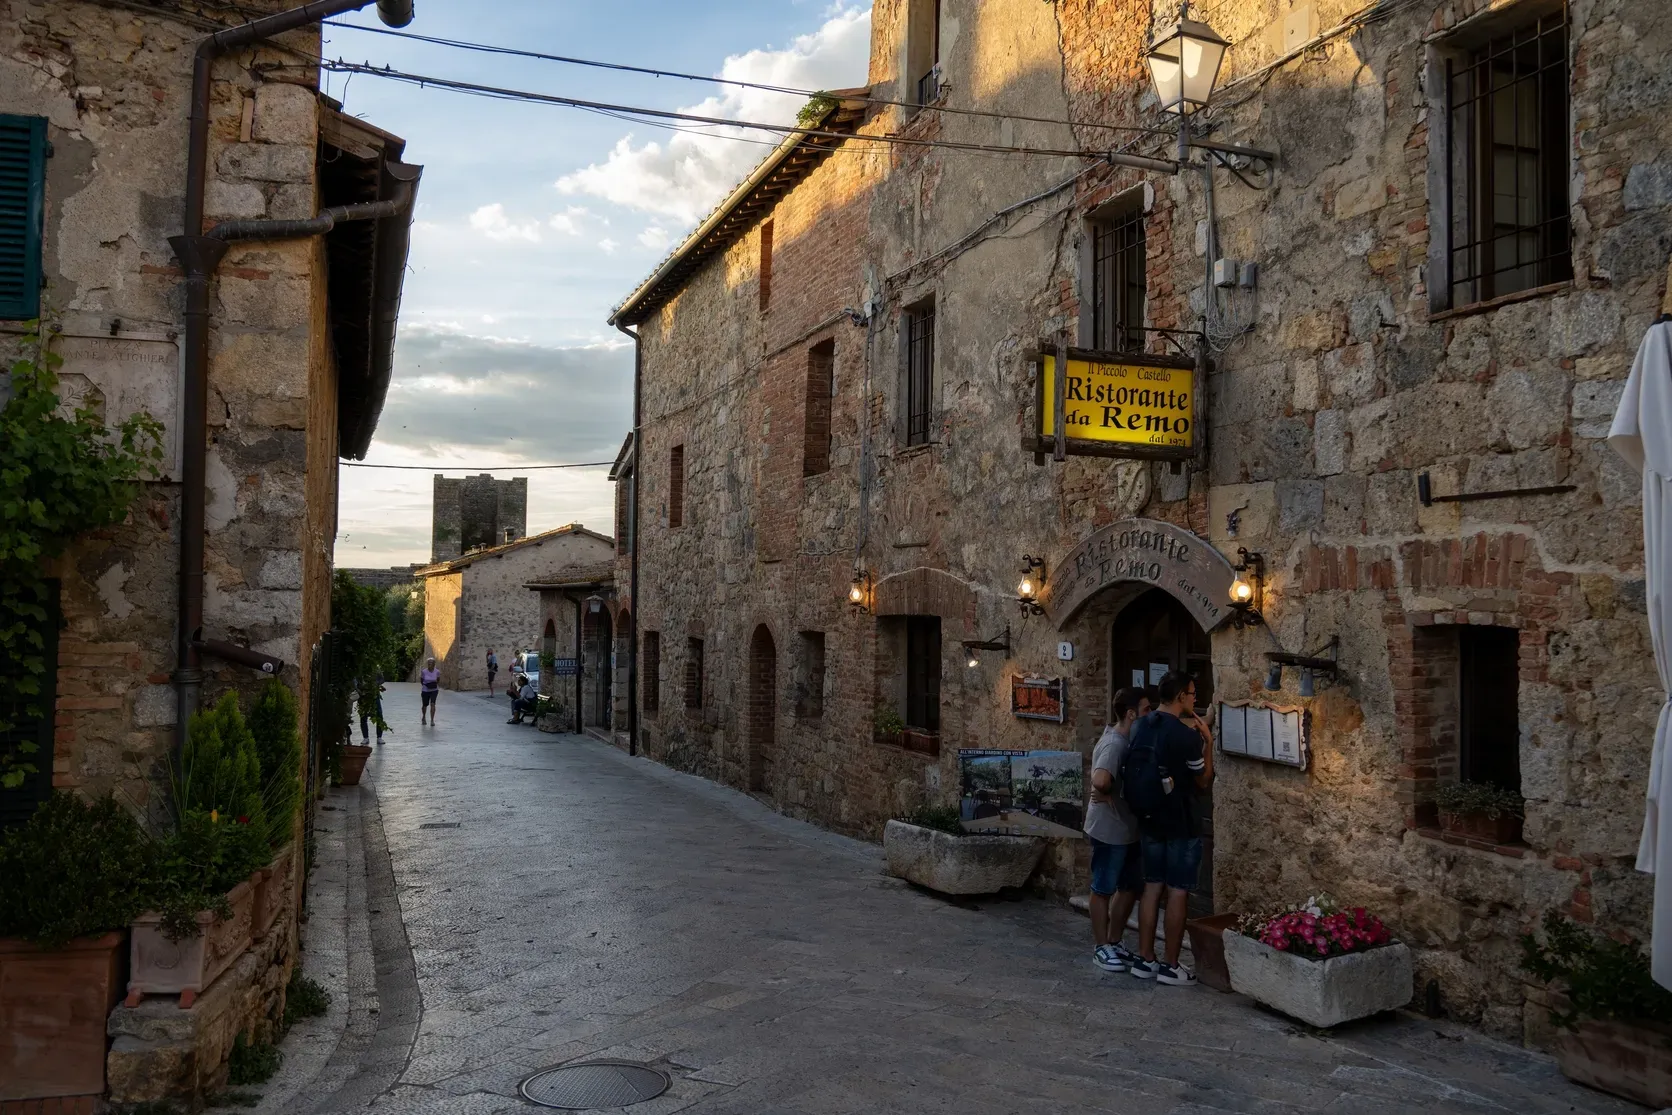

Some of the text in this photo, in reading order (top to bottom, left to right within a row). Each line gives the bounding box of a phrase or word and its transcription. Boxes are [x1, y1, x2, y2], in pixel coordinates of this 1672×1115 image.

[58, 350, 170, 364] DANTE ALIGHIERI
[90, 340, 142, 350] PIAZZA
[1088, 362, 1172, 383] Il Piccolo Castello
[1066, 376, 1189, 411] Ristorante
[1065, 405, 1190, 434] da Remo
[1149, 434, 1165, 443] dal
[1073, 529, 1190, 580] Ristorante
[1098, 557, 1163, 586] Remo
[1177, 578, 1220, 618] dal 1974
[1062, 645, 1067, 657] 2
